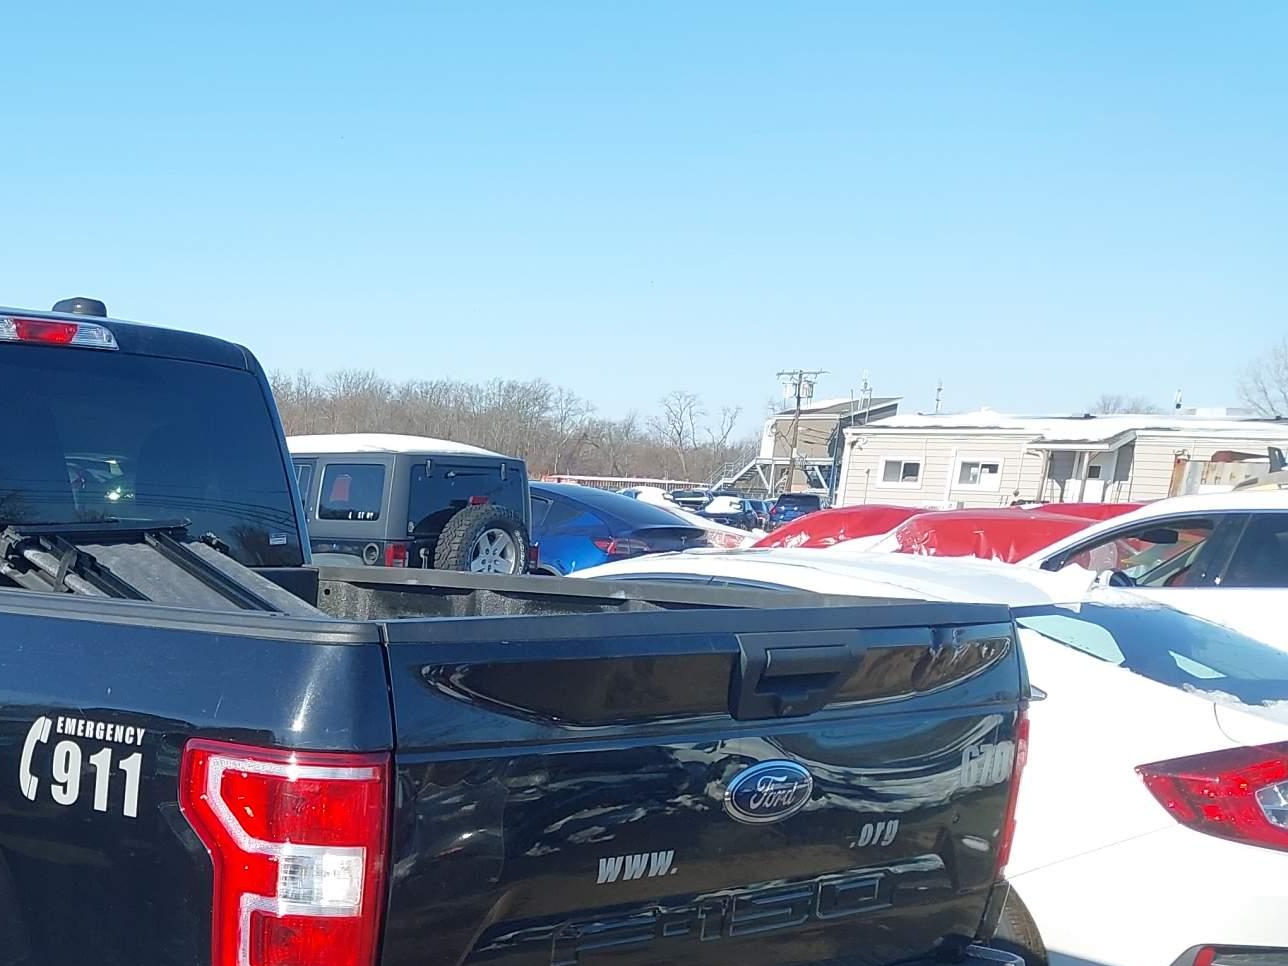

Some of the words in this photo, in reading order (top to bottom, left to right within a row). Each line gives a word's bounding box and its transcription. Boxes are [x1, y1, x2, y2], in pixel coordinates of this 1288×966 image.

[56, 716, 145, 746] EMERGENCY
[50, 740, 143, 818] 911
[750, 775, 799, 810] Ford
[596, 850, 679, 884] www.
[849, 819, 900, 848] .org
